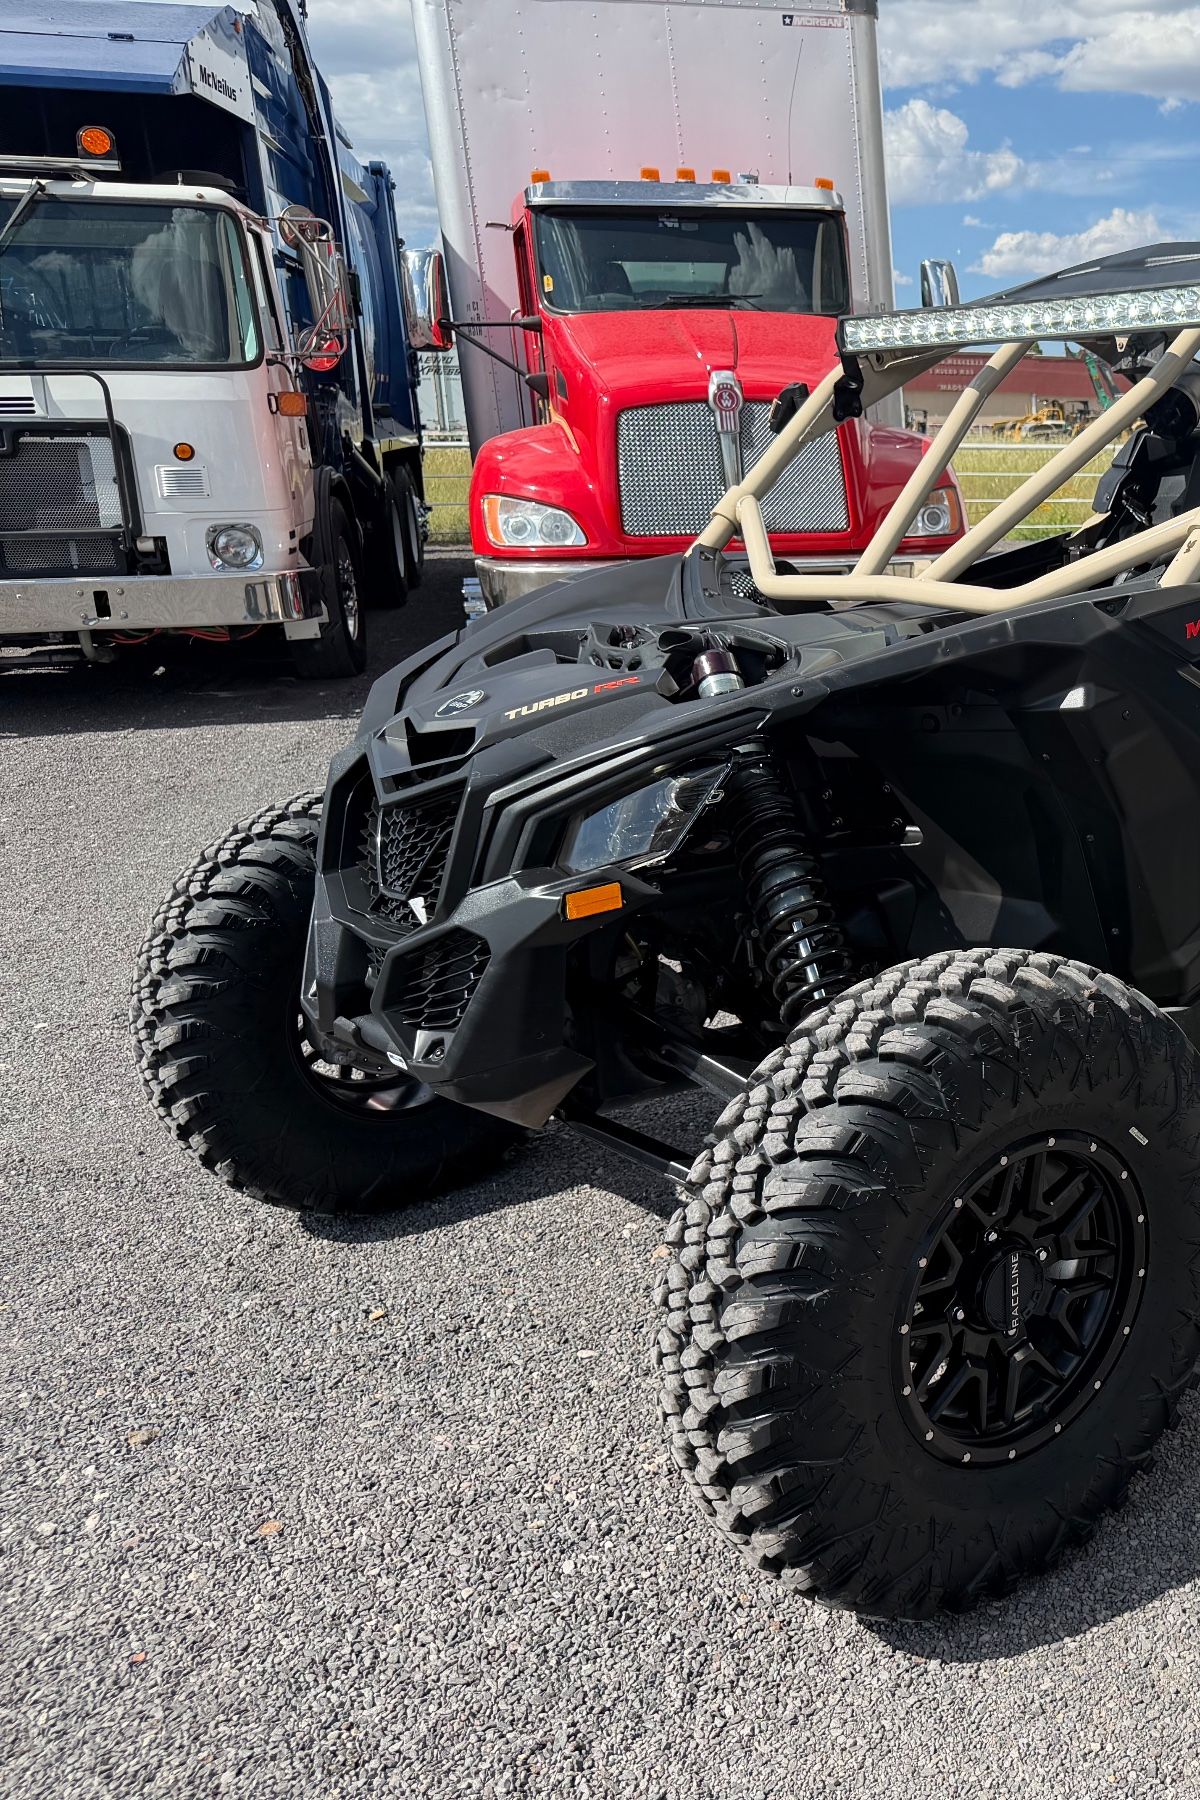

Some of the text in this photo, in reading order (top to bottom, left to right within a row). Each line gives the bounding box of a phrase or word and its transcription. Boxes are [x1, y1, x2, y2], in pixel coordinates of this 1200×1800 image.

[796, 15, 842, 27] MORGAN
[199, 64, 237, 102] McNeilus
[504, 688, 589, 720] TURBO
[1011, 1252, 1020, 1328] RACELINE
